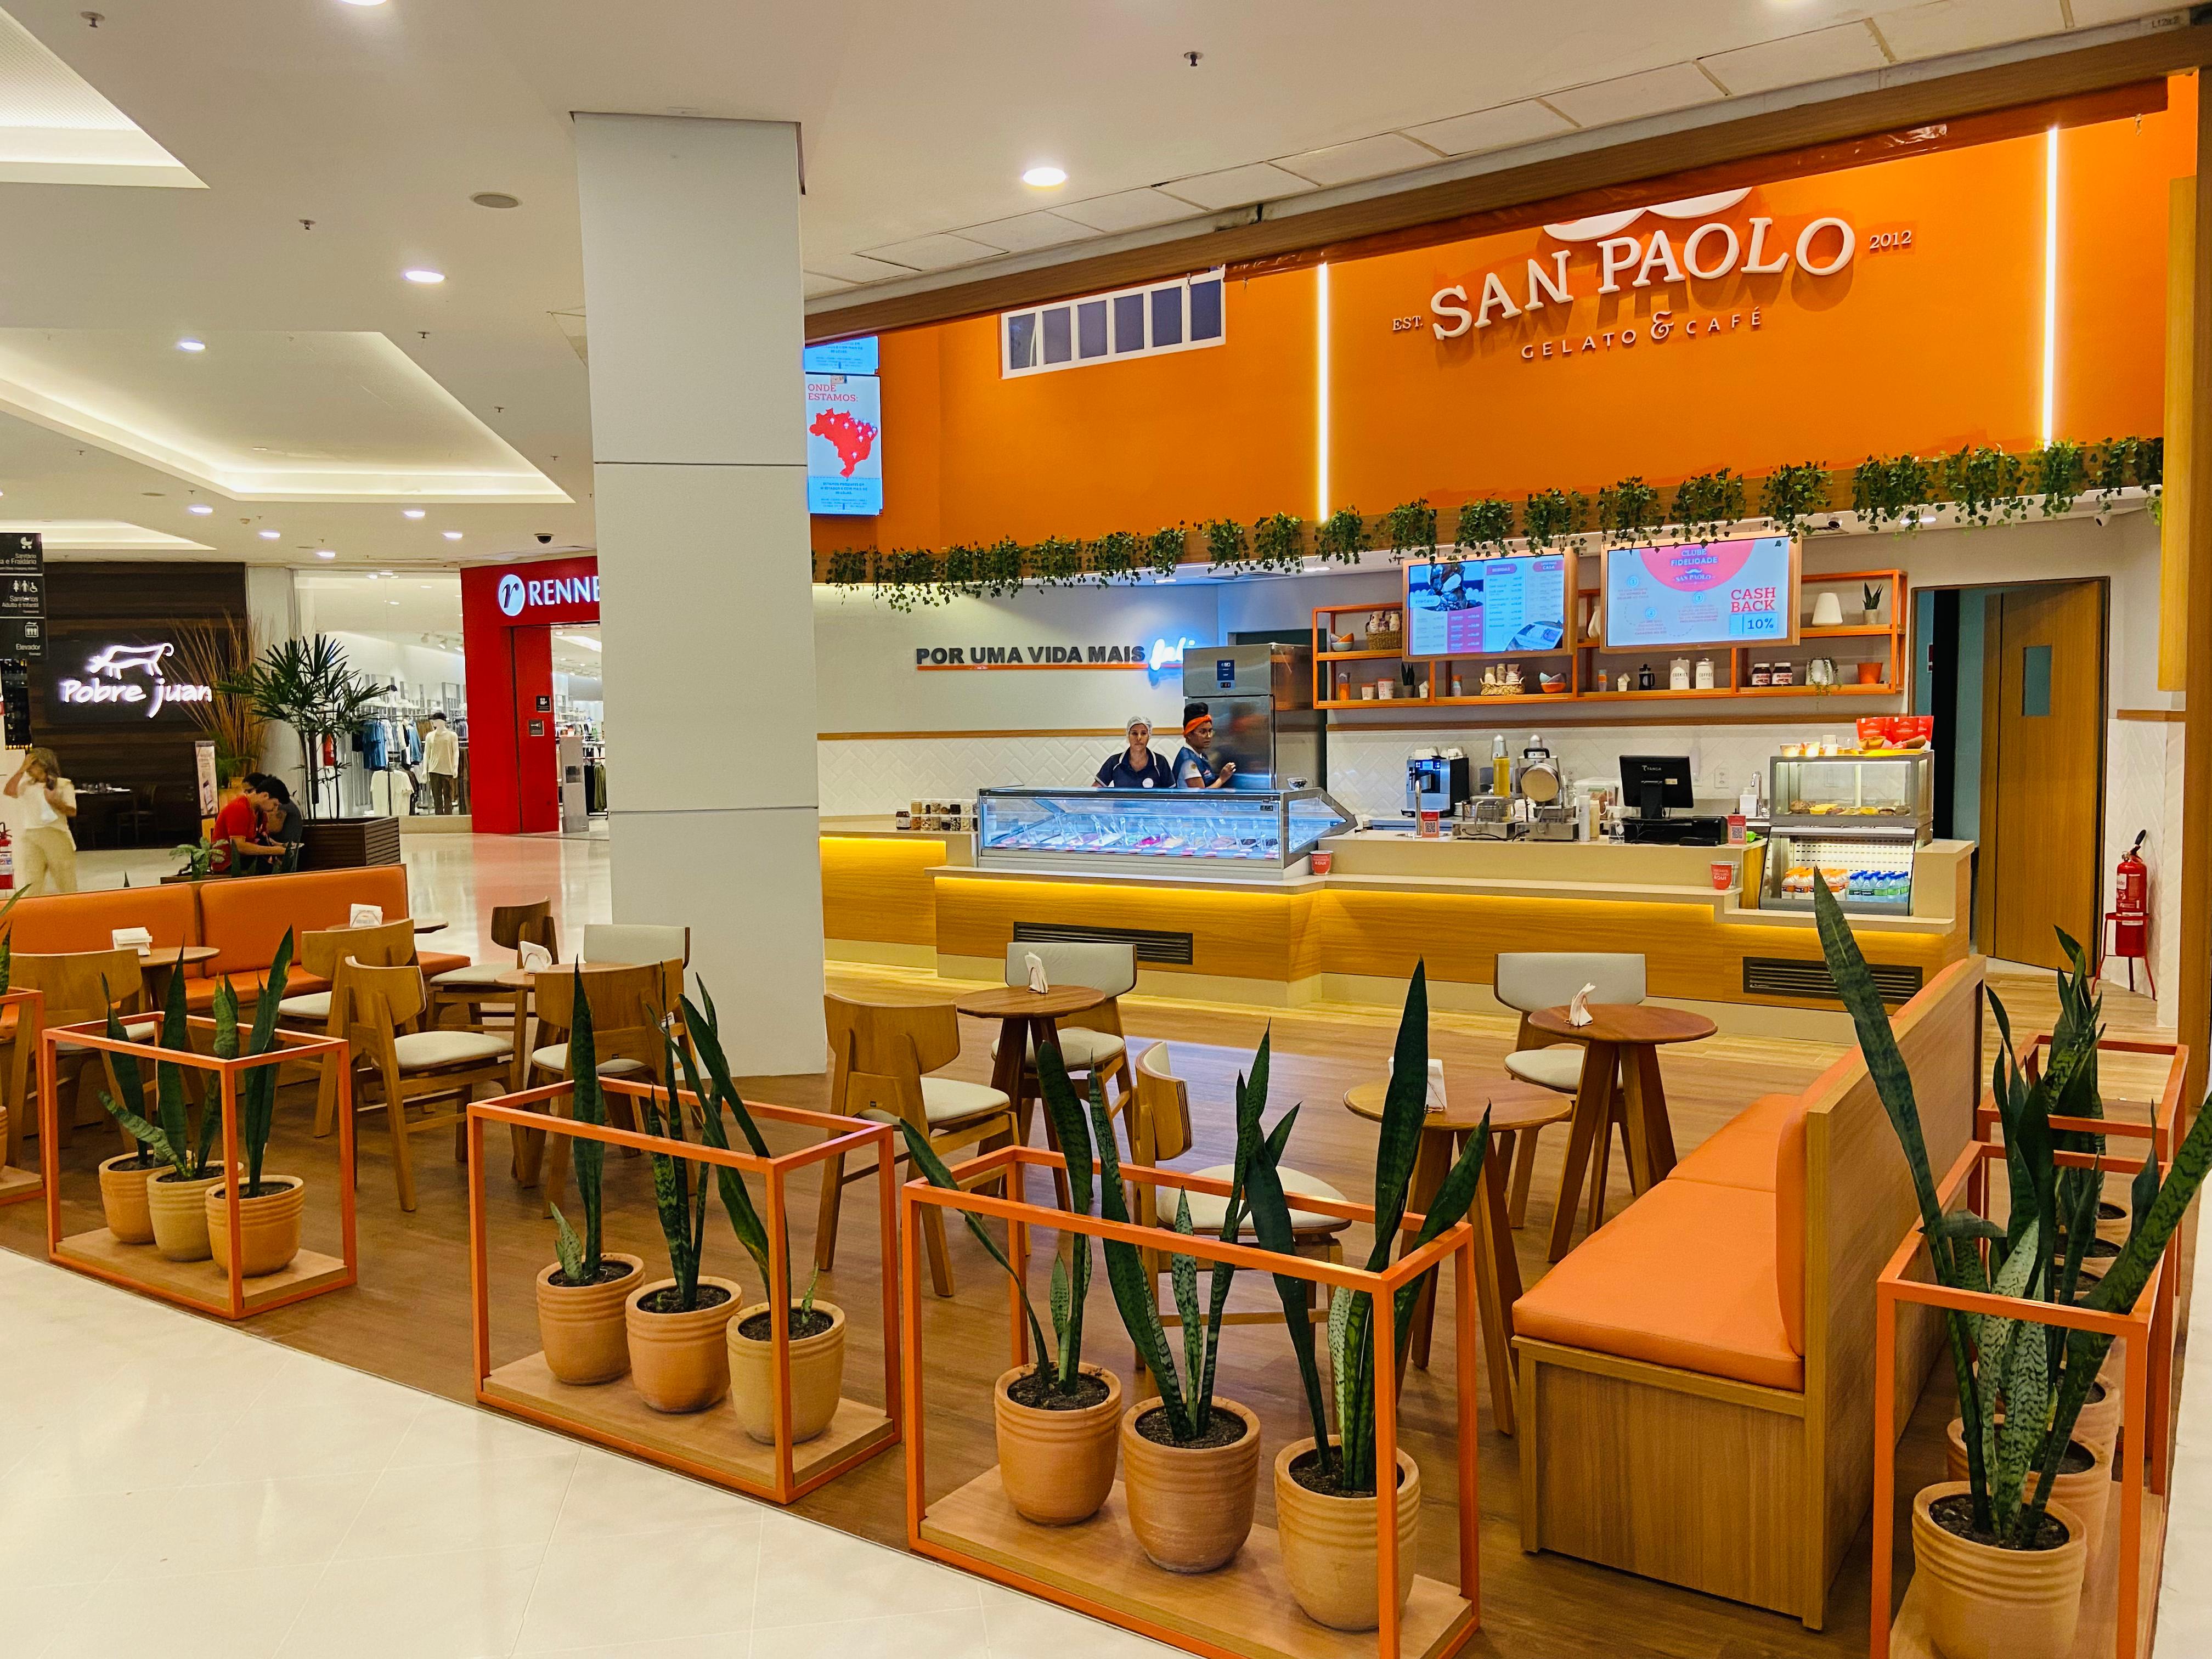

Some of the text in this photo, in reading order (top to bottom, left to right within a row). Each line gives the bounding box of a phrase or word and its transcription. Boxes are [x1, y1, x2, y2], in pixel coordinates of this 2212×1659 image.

[1392, 217, 1912, 341] EST. SAN PAOLO 2012
[1521, 306, 1763, 359] GELATO & CAFÉ
[808, 383, 836, 392] ONDE
[808, 393, 859, 402] ESTAMOS:
[1671, 556, 1718, 566] FIDELIDADE
[1731, 587, 1776, 600] CASH
[1731, 599, 1775, 613] BACK
[1747, 617, 1774, 630] 10%
[916, 647, 964, 665] POR
[970, 647, 1023, 664] UMA
[1028, 646, 1083, 663] VIDA
[1088, 646, 1146, 663] MAIS
[60, 678, 213, 719] Pobre juan
